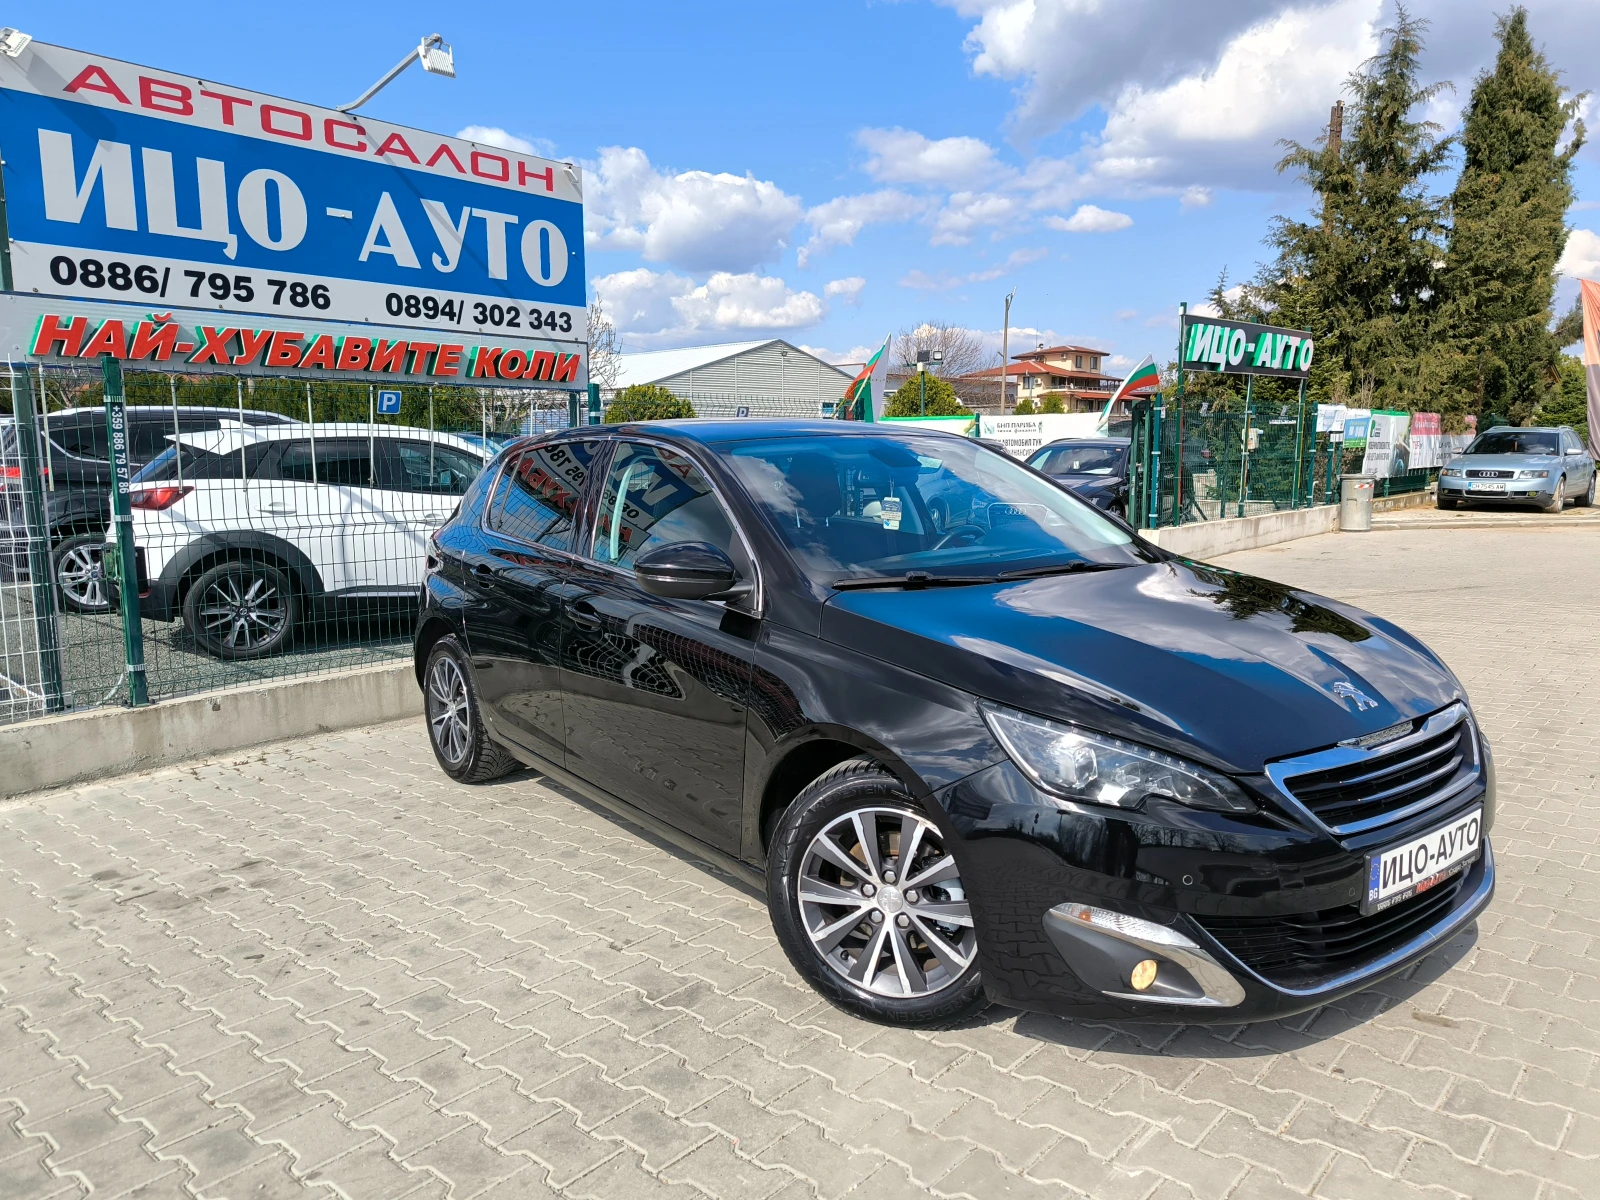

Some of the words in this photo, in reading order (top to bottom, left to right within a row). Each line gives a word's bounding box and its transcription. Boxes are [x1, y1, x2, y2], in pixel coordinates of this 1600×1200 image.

[63, 64, 555, 193] АВТОСАЛОН
[37, 127, 308, 261] ИЦО
[50, 255, 170, 298] 0886/
[183, 269, 255, 303] 795
[266, 278, 331, 310] 786
[385, 292, 464, 325] 0894/
[473, 302, 521, 328] 302
[528, 308, 572, 333] 343
[31, 311, 464, 377] НАЙ-ХУБАВИТЕ
[471, 346, 581, 383] КОЛИ
[1187, 323, 1314, 372] ИЦО-АУТО
[111, 405, 123, 430] +359
[382, 393, 397, 411] P
[112, 432, 125, 450] 886
[115, 452, 127, 465] 79
[116, 467, 128, 479] 57
[118, 481, 130, 494] 86
[1382, 817, 1479, 890] ИЦО-АУТО
[1368, 887, 1379, 901] BG
